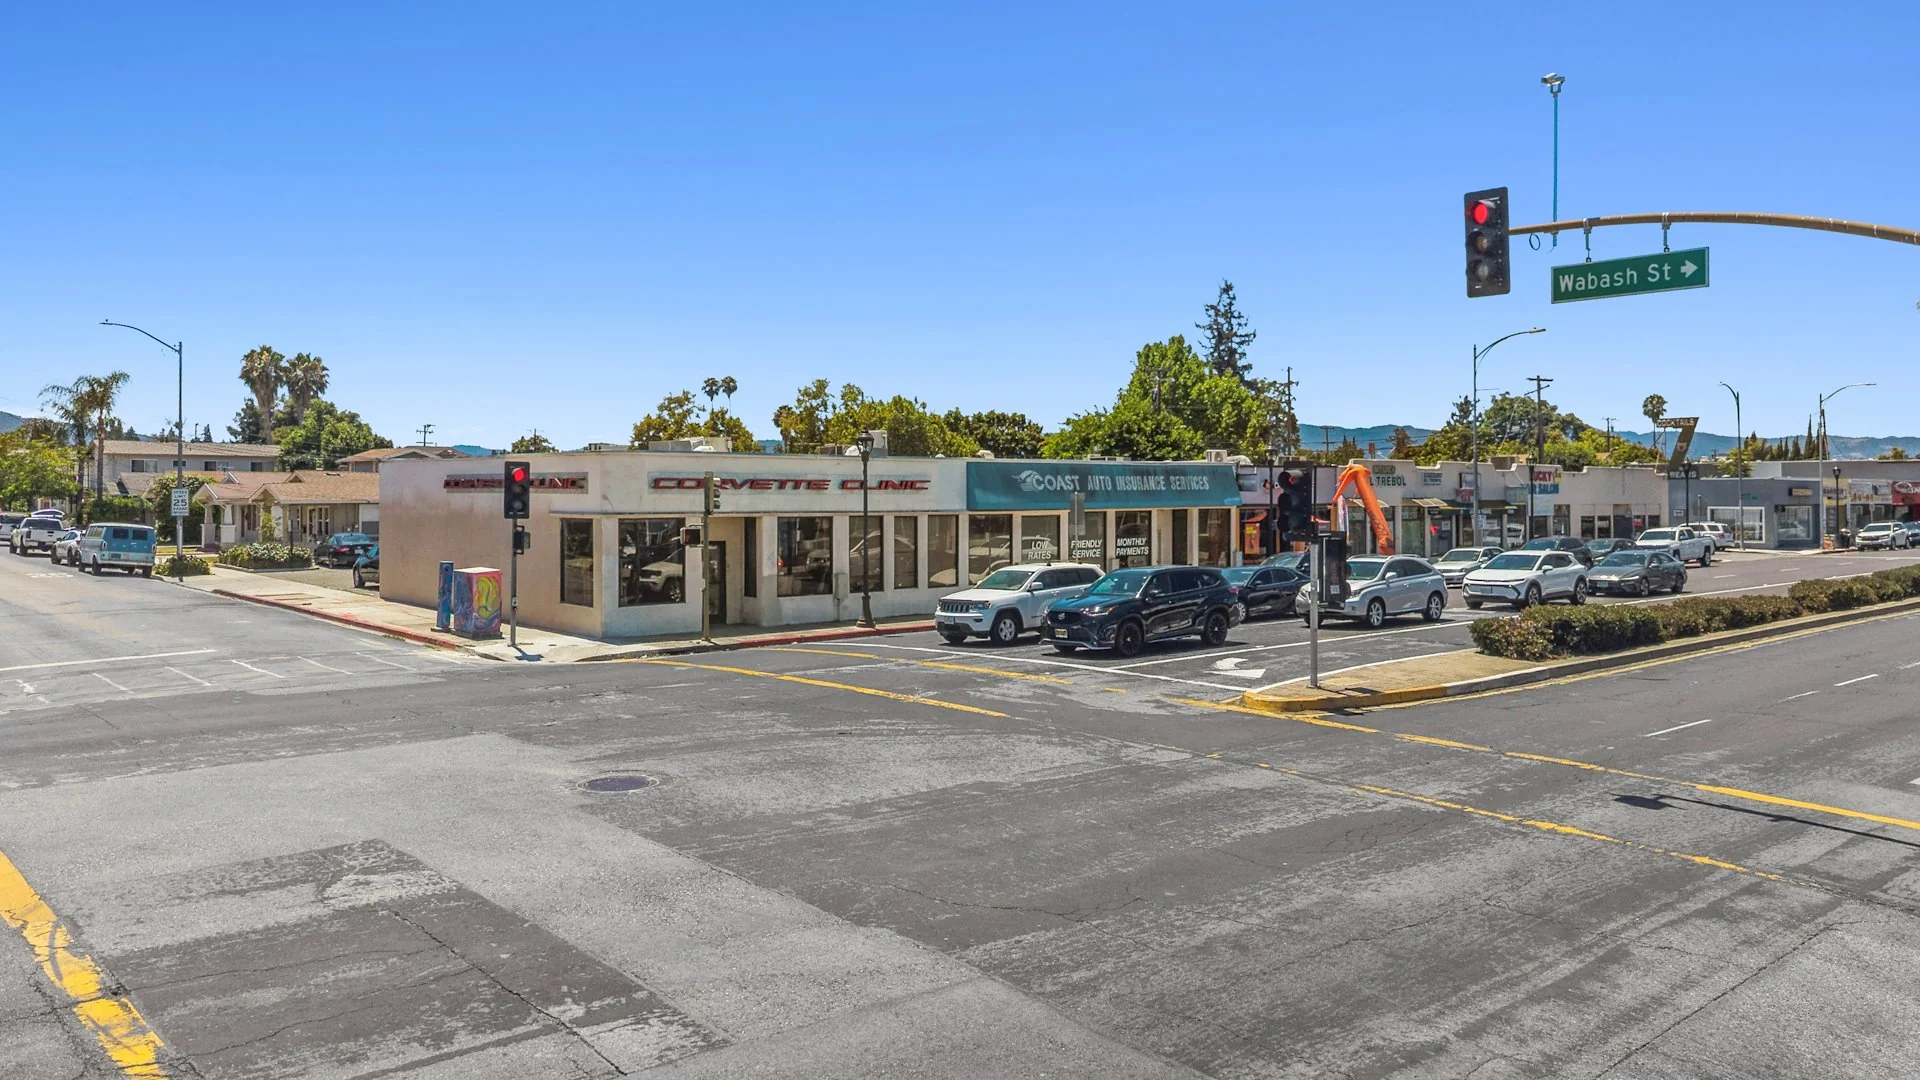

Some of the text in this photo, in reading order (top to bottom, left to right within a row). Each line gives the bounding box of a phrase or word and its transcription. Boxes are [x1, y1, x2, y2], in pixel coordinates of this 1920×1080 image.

[1559, 262, 1671, 292] Wabash St
[1657, 418, 1694, 427] COCKTAILS
[1530, 471, 1552, 481] UCKY
[839, 479, 931, 490] CLINIC
[1033, 474, 1210, 491] COAST AUTO INSURANCE SERVICES
[1376, 476, 1406, 487] TREBOL
[1032, 541, 1048, 550] LOW
[1071, 540, 1102, 549] FRIENDLY
[1117, 537, 1147, 546] MONTHLY
[1028, 551, 1051, 560] RATES
[1072, 549, 1100, 558] SERVICE
[1116, 547, 1149, 556] PAYMENTS
